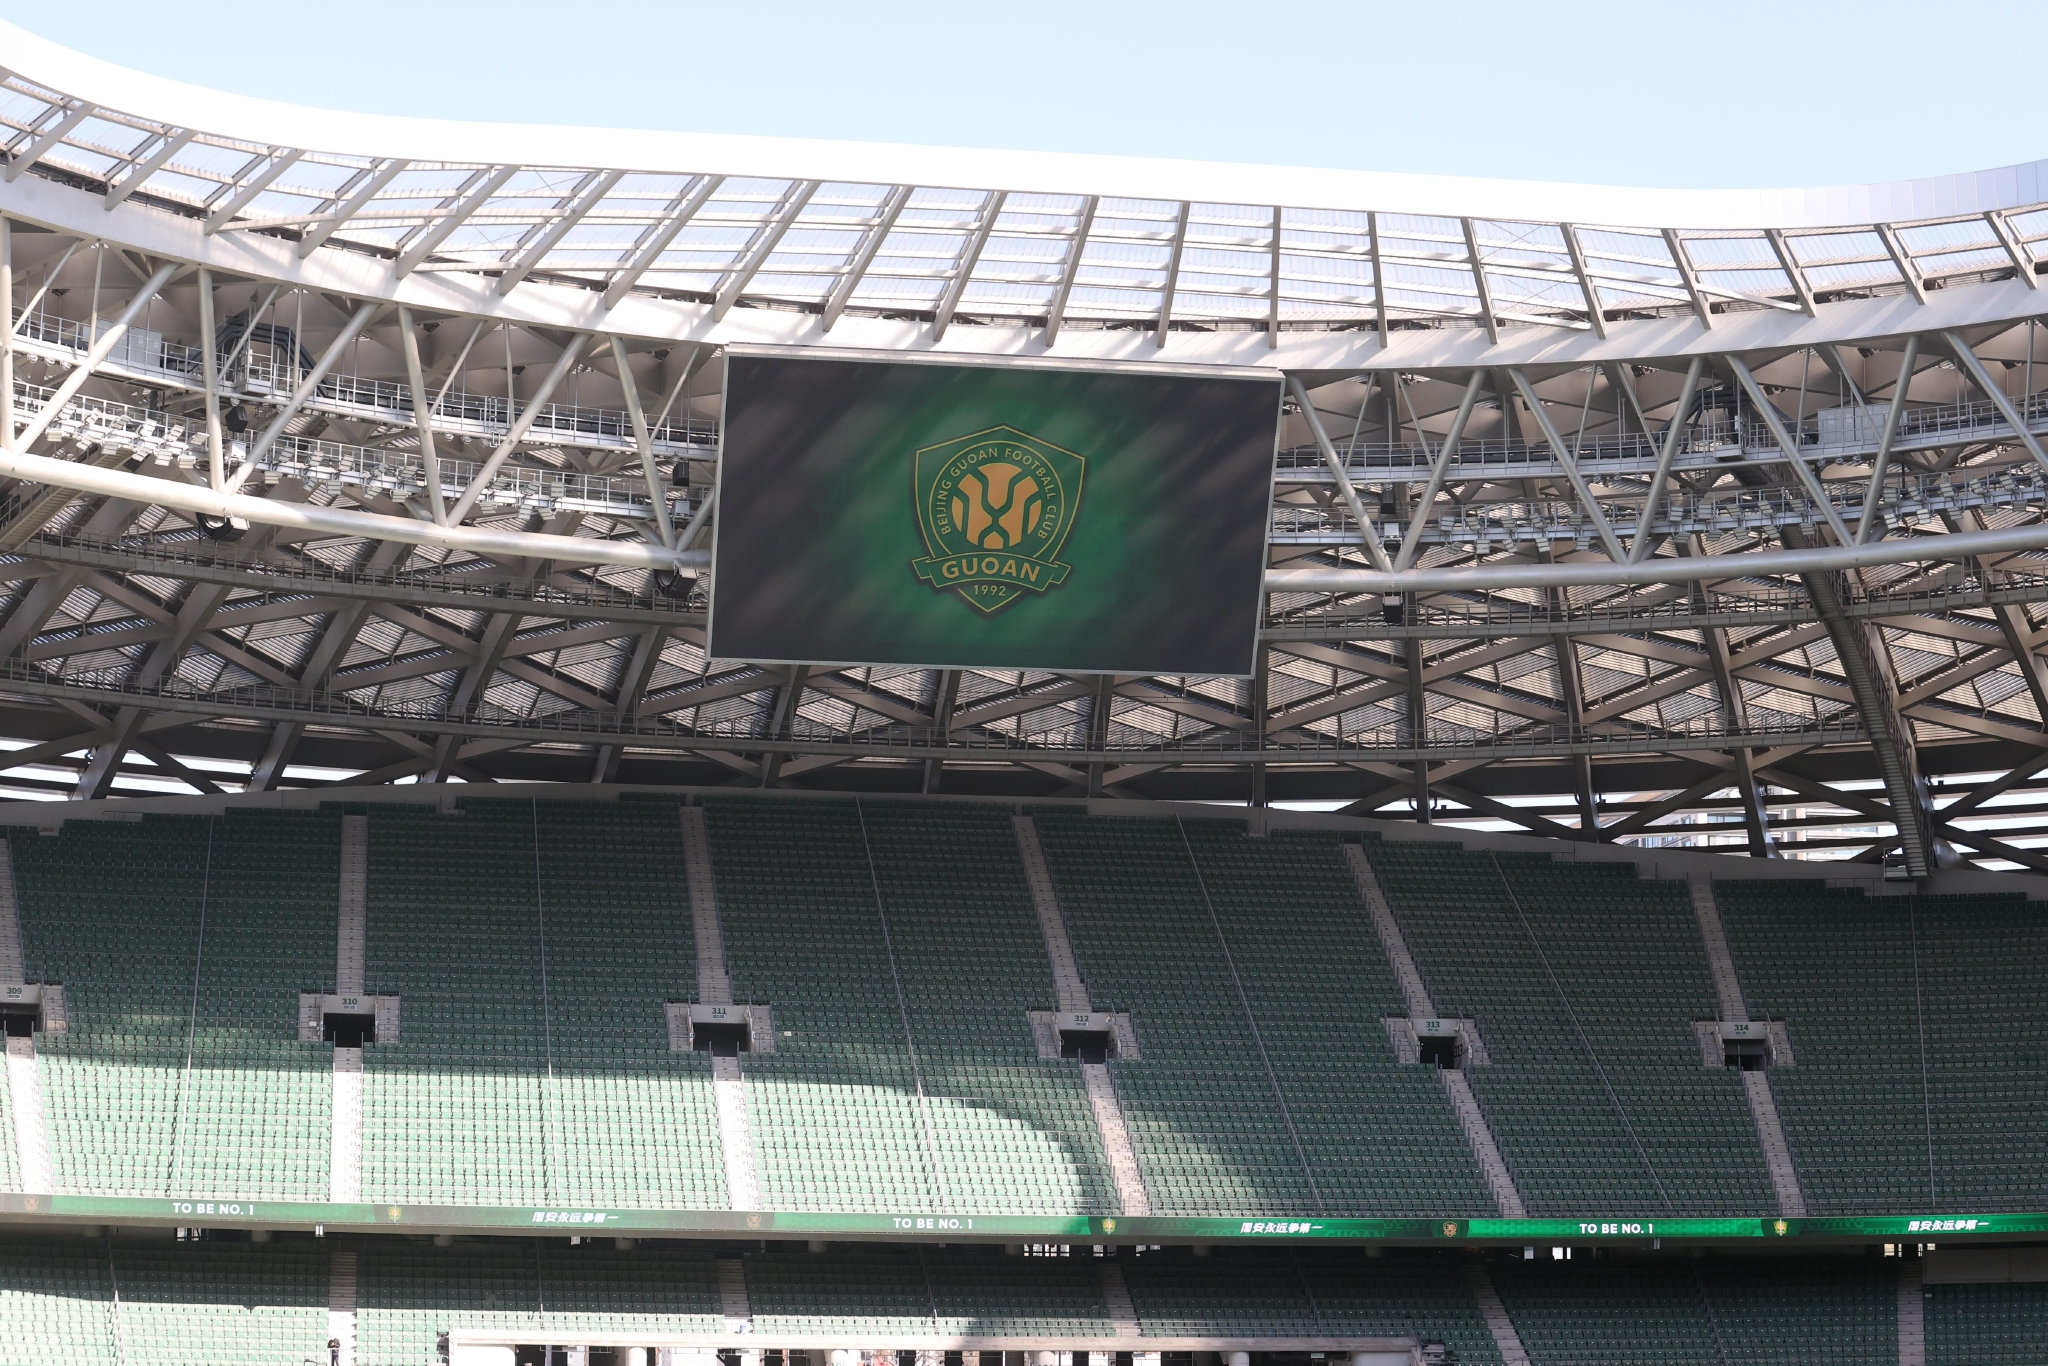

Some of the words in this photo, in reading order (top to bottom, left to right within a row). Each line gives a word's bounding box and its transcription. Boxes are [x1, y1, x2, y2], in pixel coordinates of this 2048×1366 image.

[936, 479, 952, 535] BEIJING
[950, 447, 998, 477] GUOAN
[1004, 448, 1056, 500] FOOTBALL
[1037, 505, 1057, 540] CLUB
[941, 557, 1041, 582] GUOAN
[973, 584, 1006, 597] 1992
[6, 987, 23, 995] 309
[711, 1007, 727, 1015] 311
[172, 1202, 192, 1214] TO
[196, 1203, 215, 1214] BE
[218, 1203, 244, 1215] NO.
[248, 1204, 254, 1216] 1
[892, 1218, 912, 1229] TO
[916, 1218, 934, 1229] BE
[938, 1218, 963, 1230] NO.
[967, 1219, 973, 1230] 1
[1579, 1223, 1598, 1234] TO
[1601, 1223, 1618, 1234] BE
[1621, 1223, 1644, 1234] NO.
[1648, 1223, 1653, 1234] 1
